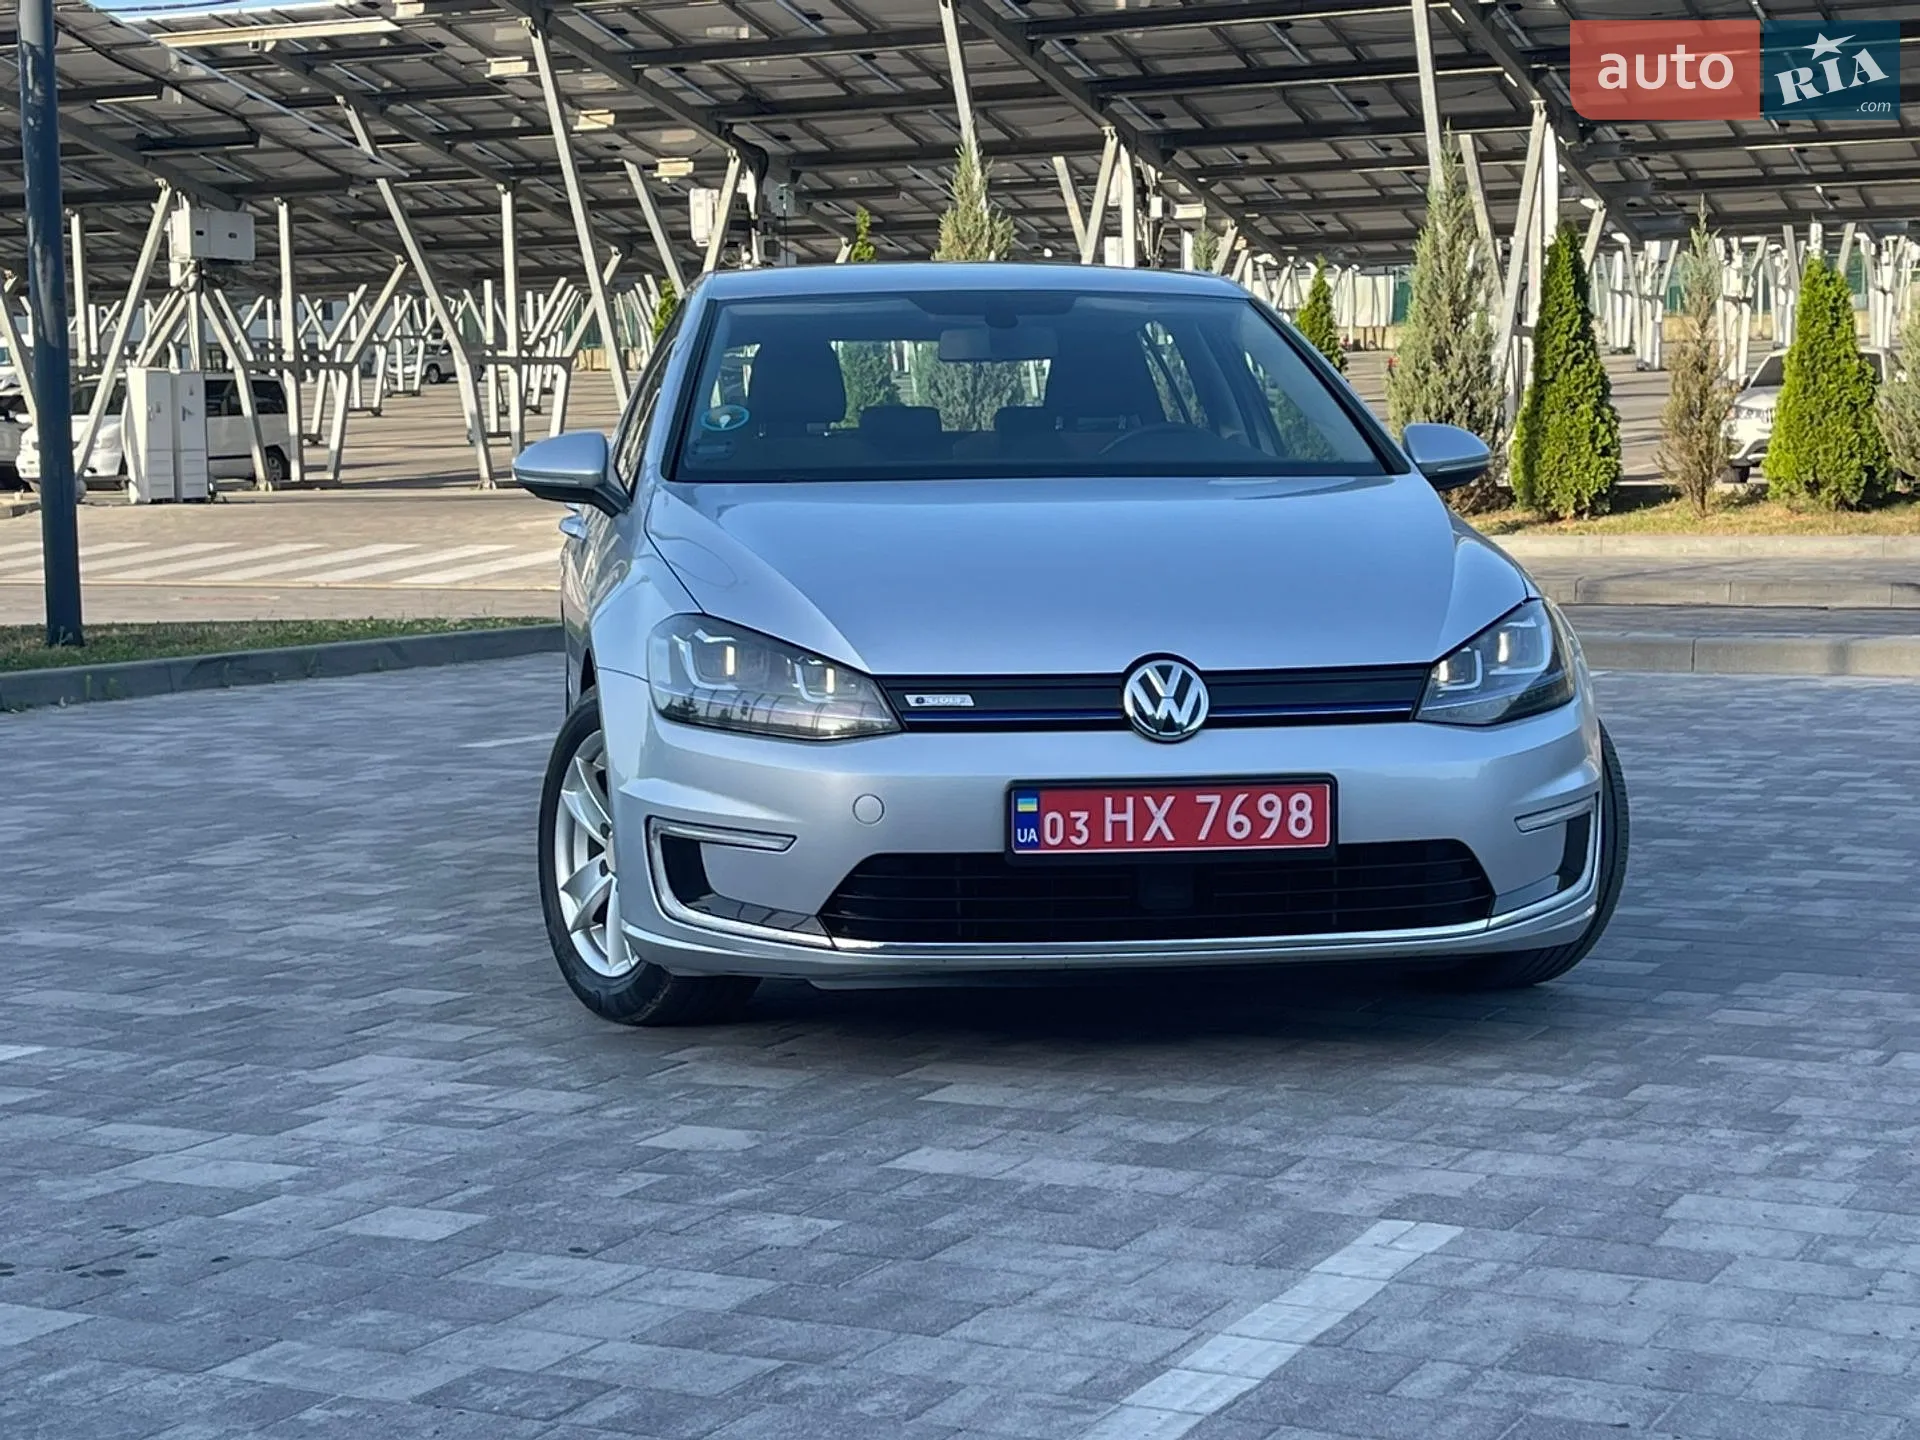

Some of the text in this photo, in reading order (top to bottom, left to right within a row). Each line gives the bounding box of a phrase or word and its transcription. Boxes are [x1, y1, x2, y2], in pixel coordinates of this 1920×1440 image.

[1125, 660, 1209, 736] VW
[1016, 828, 1038, 843] UA
[1043, 793, 1313, 846] 03 HX 7698
